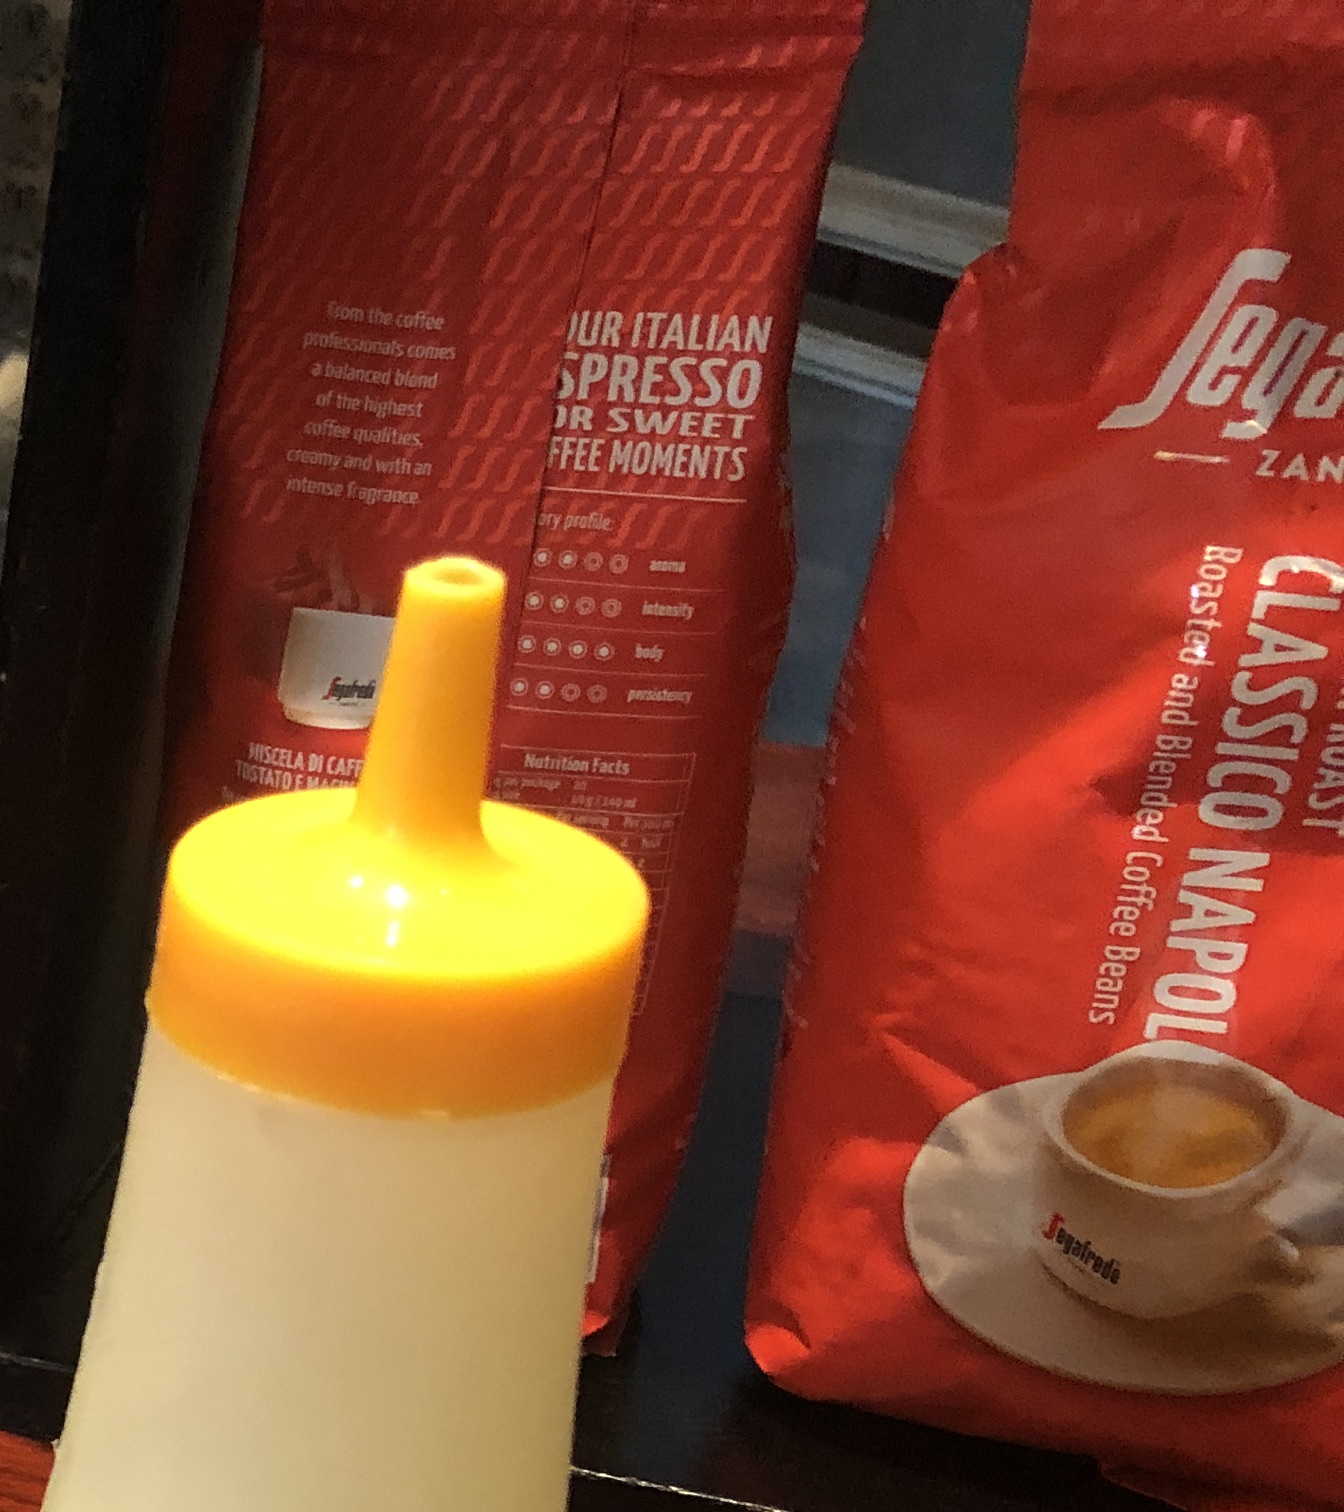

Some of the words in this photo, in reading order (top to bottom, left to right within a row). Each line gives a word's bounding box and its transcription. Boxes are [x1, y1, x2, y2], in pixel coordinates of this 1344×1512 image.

[368, 307, 393, 325] the
[396, 311, 445, 330] coffee
[632, 312, 773, 353] ITALIAN
[302, 331, 405, 358] professionals
[407, 345, 456, 360] comes
[1098, 248, 1344, 440] Sega
[311, 363, 322, 377] a
[325, 363, 391, 385] balanced
[394, 369, 438, 389] blend
[557, 352, 763, 409] SPRESSO
[315, 390, 333, 407] of
[336, 394, 360, 411] the
[364, 395, 424, 418] highest
[304, 418, 351, 438] coffee
[606, 407, 756, 439] SWEET
[287, 449, 341, 470] creamy
[344, 455, 372, 471] and
[376, 457, 411, 475] with
[414, 462, 432, 476] an
[547, 436, 606, 472] FFEE
[609, 440, 748, 482] MOMENTS
[1255, 449, 1344, 484] ZAN
[286, 476, 343, 497] intense
[1178, 545, 1244, 667] Roasted
[1161, 673, 1199, 726] and
[1198, 556, 1344, 831] CLASSICO
[236, 759, 292, 790] TOSTATO
[248, 742, 304, 771] MISCELA
[308, 753, 324, 773] DI
[327, 756, 365, 777] CAFF
[524, 753, 589, 772] Nutrition
[593, 757, 630, 775] Facts
[1131, 734, 1193, 843] Blended
[1109, 851, 1163, 937] Coffee
[1089, 944, 1141, 1025] Beans
